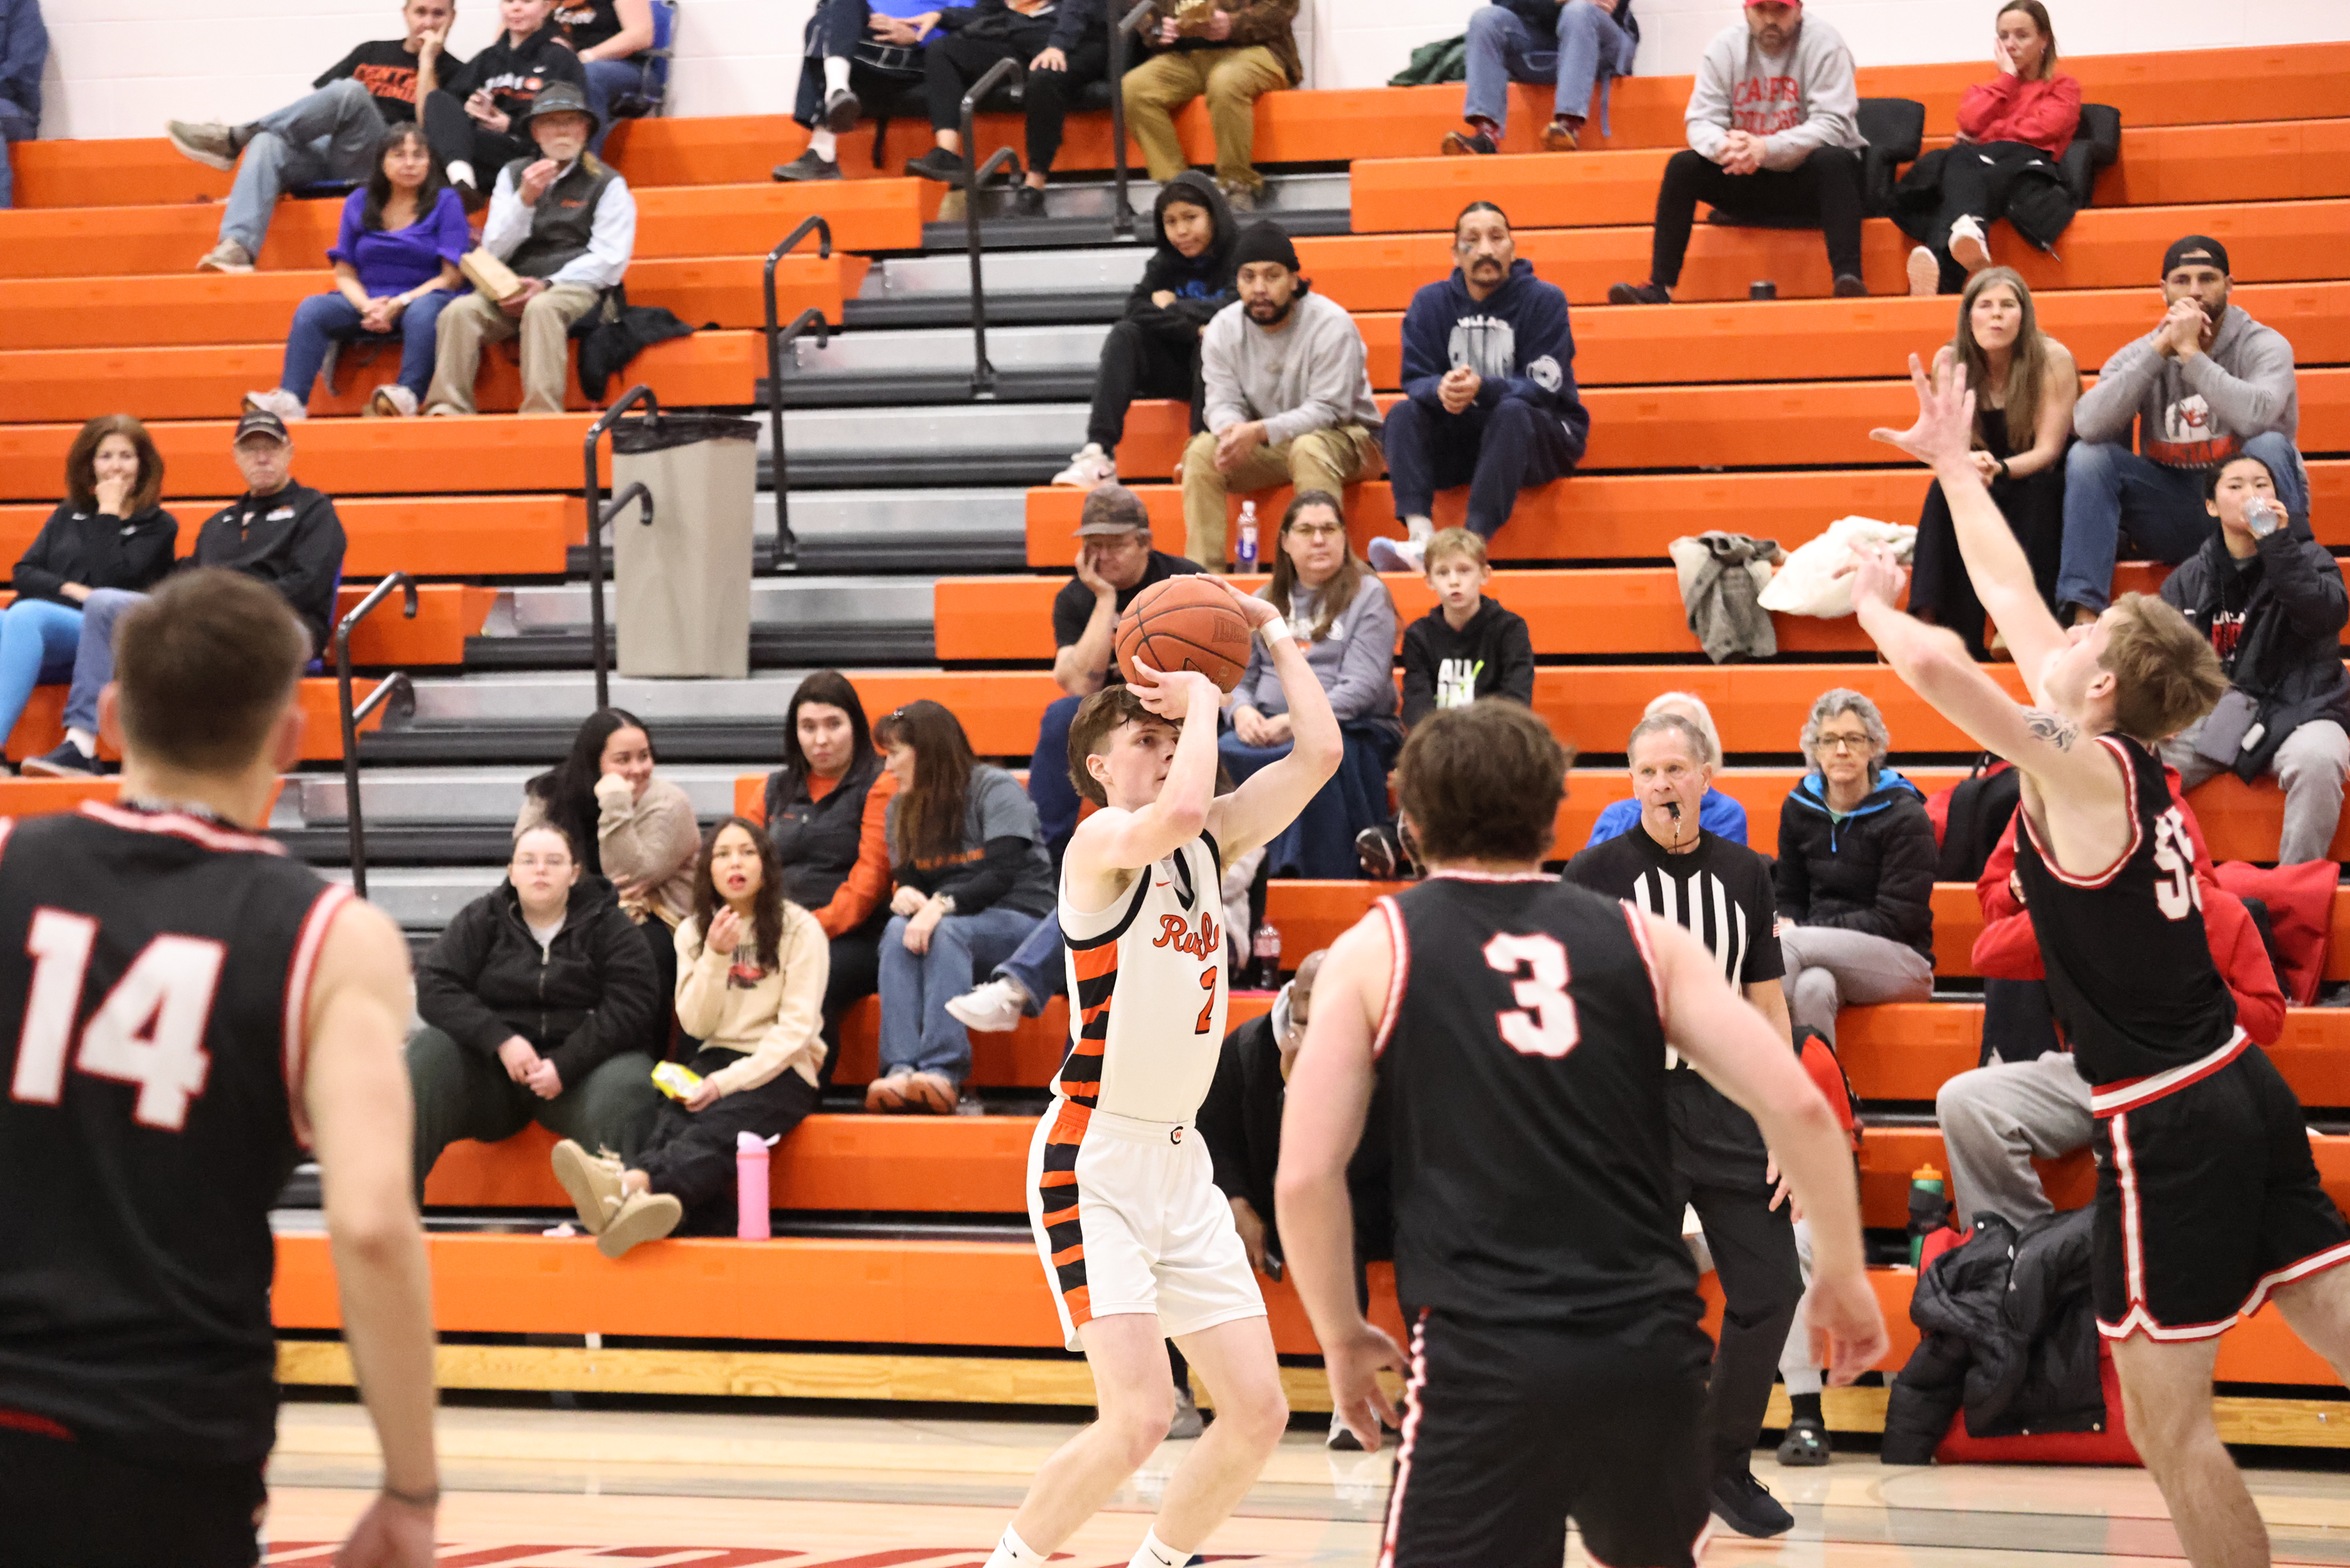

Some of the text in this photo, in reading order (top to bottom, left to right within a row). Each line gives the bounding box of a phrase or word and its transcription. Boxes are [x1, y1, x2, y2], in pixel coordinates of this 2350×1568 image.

[1438, 658, 1473, 681] ALL
[9, 905, 228, 1133] 14
[1481, 929, 1582, 1060] 3
